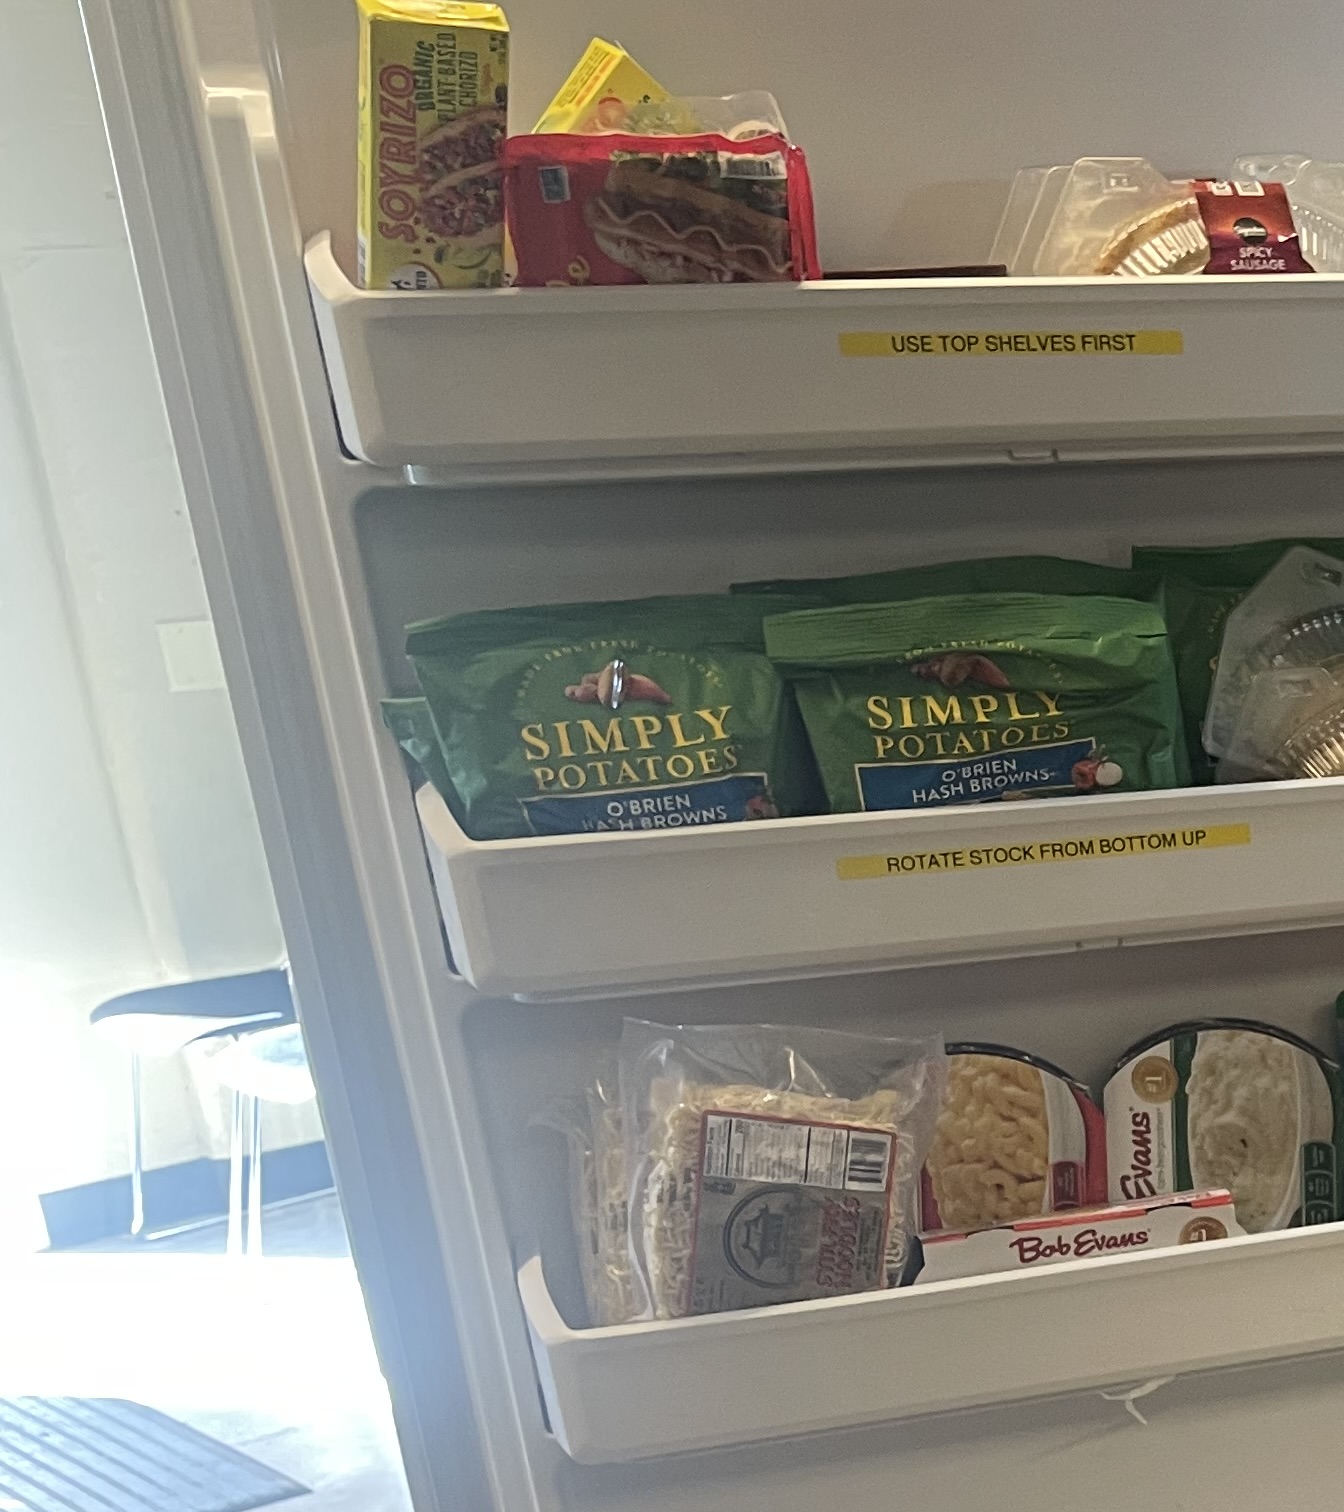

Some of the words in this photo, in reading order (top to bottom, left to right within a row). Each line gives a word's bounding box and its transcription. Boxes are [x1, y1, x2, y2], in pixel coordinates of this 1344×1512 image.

[414, 40, 436, 112] ORGANIC
[459, 51, 478, 108] CHORIZO
[378, 64, 417, 244] SOYRIZO
[1230, 258, 1286, 271] SAUSAGE
[1238, 246, 1273, 261] SPICY
[891, 334, 934, 353] USE
[942, 334, 979, 352] TOP
[984, 333, 1076, 352] SHELVES
[1081, 333, 1136, 352] FIRST
[867, 691, 1065, 730] SIMPLY
[521, 705, 733, 761] SIMPLY
[873, 721, 1069, 759] POTATOES
[532, 745, 739, 791] POTATOES
[912, 781, 964, 804] HASH
[969, 767, 1050, 793] BROWNS
[942, 758, 1017, 782] O'BRIEN
[607, 794, 692, 818] O'BRIEN
[640, 805, 728, 830] BROWNS
[886, 850, 965, 874] ROTATE
[969, 844, 1036, 867] STOCK
[1040, 839, 1095, 861] FROM
[1098, 832, 1178, 856] BOTTOM
[1181, 829, 1208, 849] UP
[1120, 1110, 1157, 1200] Evans
[1009, 1236, 1071, 1263] Bob
[1073, 1229, 1149, 1257] Evans
